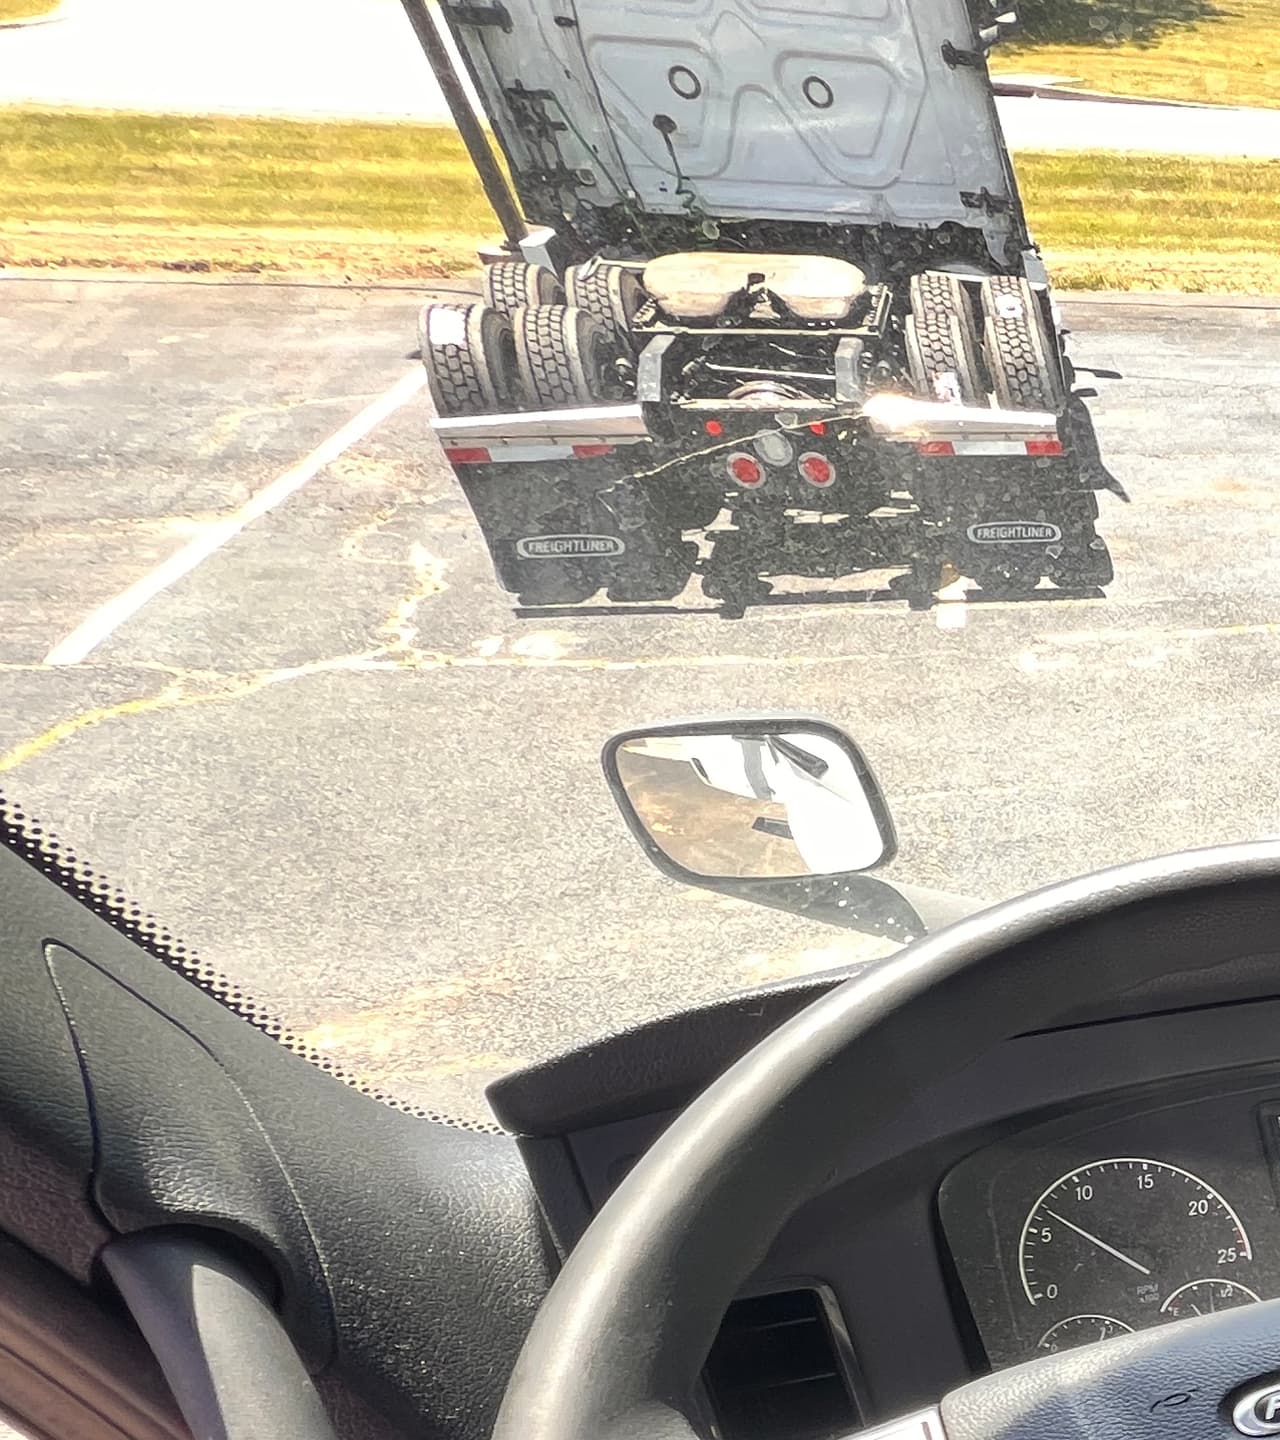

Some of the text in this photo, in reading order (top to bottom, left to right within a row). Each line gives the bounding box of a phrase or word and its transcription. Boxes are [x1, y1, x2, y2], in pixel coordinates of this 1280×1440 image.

[977, 526, 1052, 539] FREIGHTLINER
[528, 539, 614, 553] FREIGHTLINER
[1137, 1175, 1154, 1189] 15
[1075, 1185, 1093, 1200] 10
[1189, 1200, 1208, 1216] 20
[1041, 1227, 1052, 1242] 5
[1217, 1247, 1237, 1264] 25
[1047, 1284, 1058, 1299] 0
